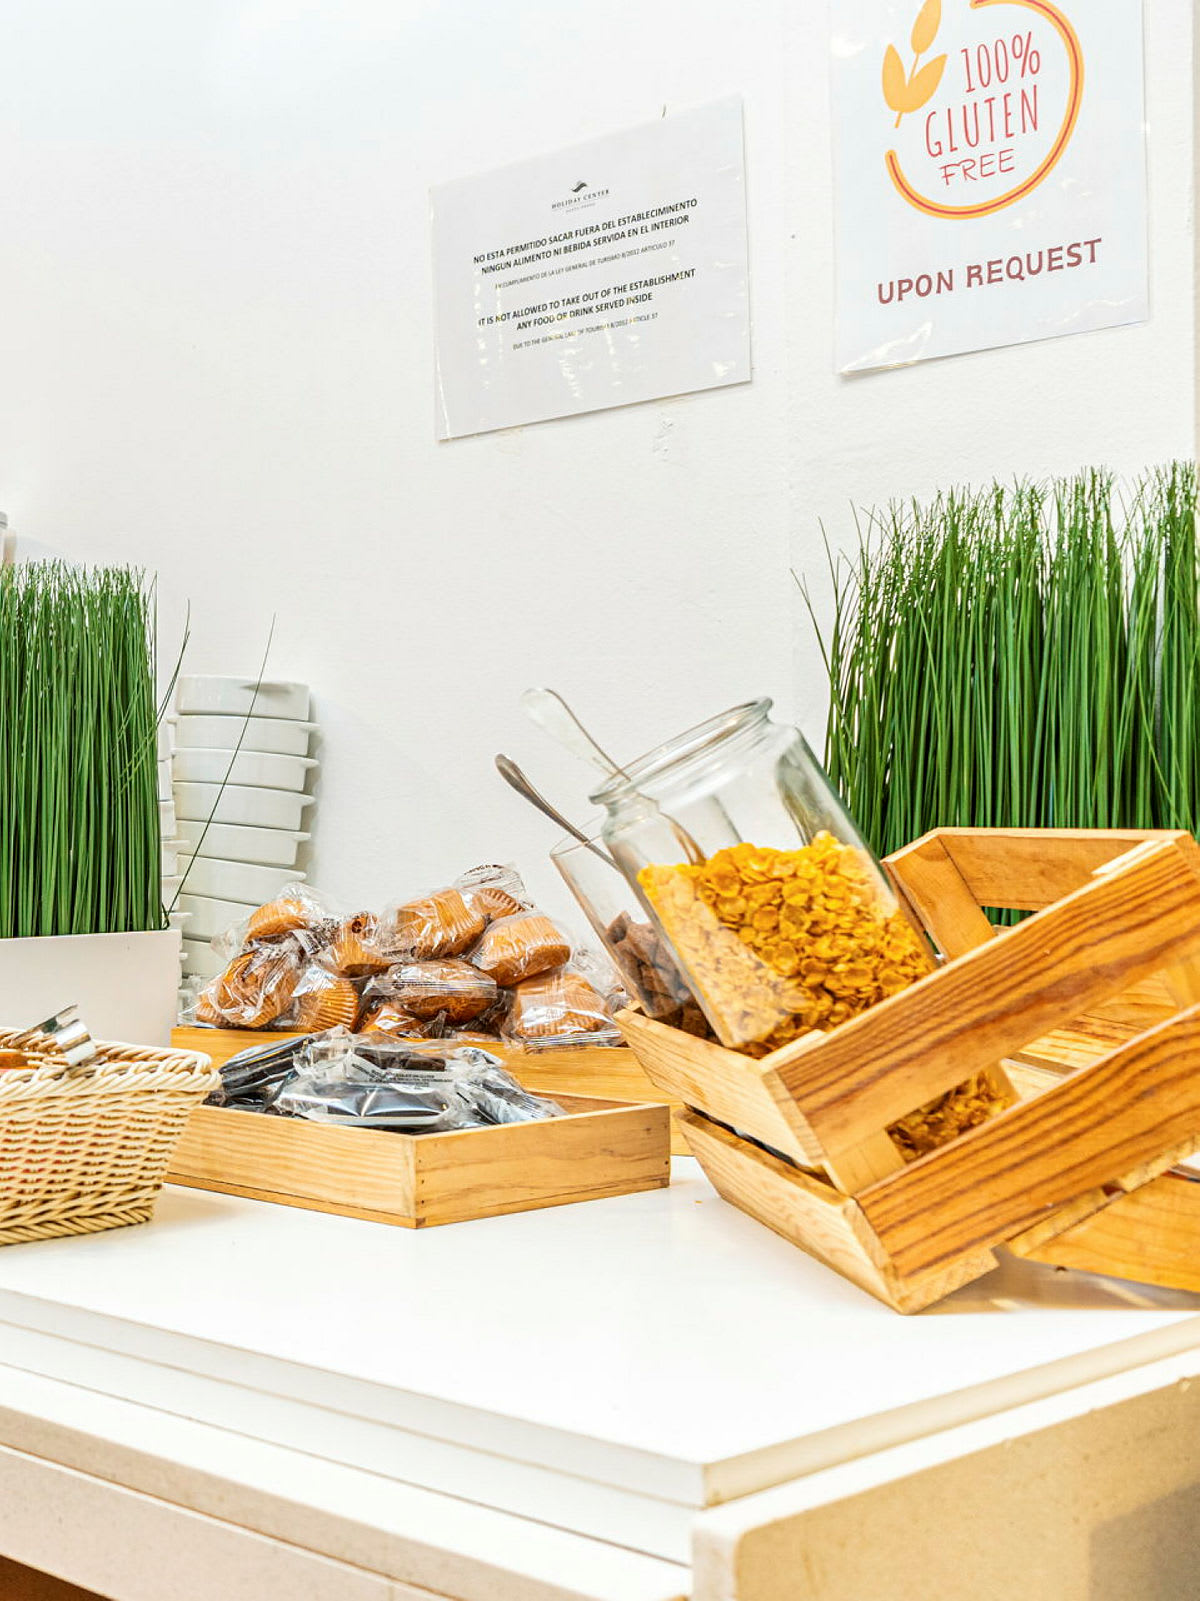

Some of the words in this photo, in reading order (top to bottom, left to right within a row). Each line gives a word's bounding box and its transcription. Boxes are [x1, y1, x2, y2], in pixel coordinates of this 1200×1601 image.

[961, 31, 1041, 94] 100%
[925, 84, 1038, 158] GLUTEN
[939, 148, 1015, 186] FREE
[551, 197, 581, 210] HOLIDAY
[582, 189, 609, 201] CENTER
[473, 254, 485, 264] NO
[486, 249, 504, 261] ESTA
[506, 238, 547, 256] PERMITIDO
[548, 230, 573, 245] SACAR
[575, 224, 600, 239] FUERA
[601, 220, 615, 231] DEL
[481, 260, 511, 276] NINGUN
[512, 249, 551, 268] ALIMENTO
[553, 247, 561, 257] NI
[563, 239, 591, 255] BEBIDA
[592, 230, 626, 247] SERVIDA
[627, 227, 638, 238] EN
[640, 225, 648, 235] EL
[650, 214, 689, 232] INTERIOR
[478, 317, 485, 326] IT
[486, 315, 493, 325] IS
[495, 311, 511, 323] NOT
[512, 303, 548, 320] ALLOWED
[549, 300, 560, 310] TO
[561, 294, 580, 307] TAKE
[581, 290, 599, 303] OUT
[600, 287, 611, 299] OF
[613, 283, 627, 295] THE
[628, 268, 695, 292] ESTABLISHMENT
[877, 269, 954, 305] UPON
[965, 238, 1102, 287] REQUEST
[516, 319, 532, 331] ANY
[533, 314, 554, 327] FOOD
[568, 305, 593, 319] DRINK
[595, 298, 624, 314] SERVED
[625, 291, 653, 306] INSIDE
